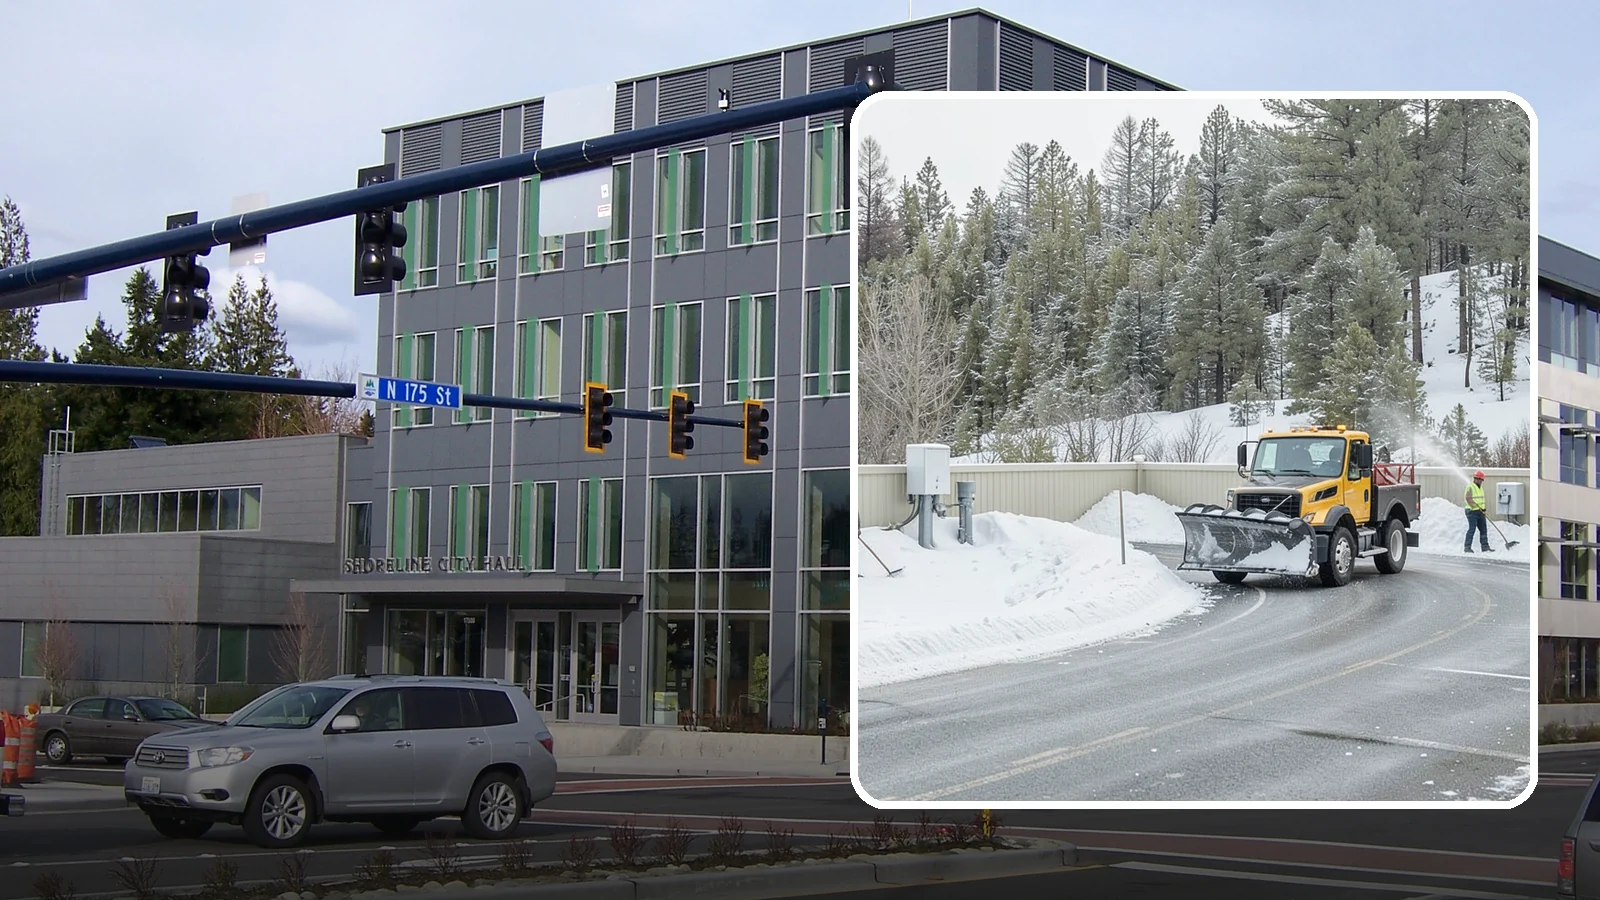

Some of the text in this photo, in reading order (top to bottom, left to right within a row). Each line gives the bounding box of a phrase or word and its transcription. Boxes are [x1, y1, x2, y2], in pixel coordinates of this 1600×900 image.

[387, 380, 452, 406] N 175 St
[344, 555, 526, 575] SHORELINE CITY HALL
